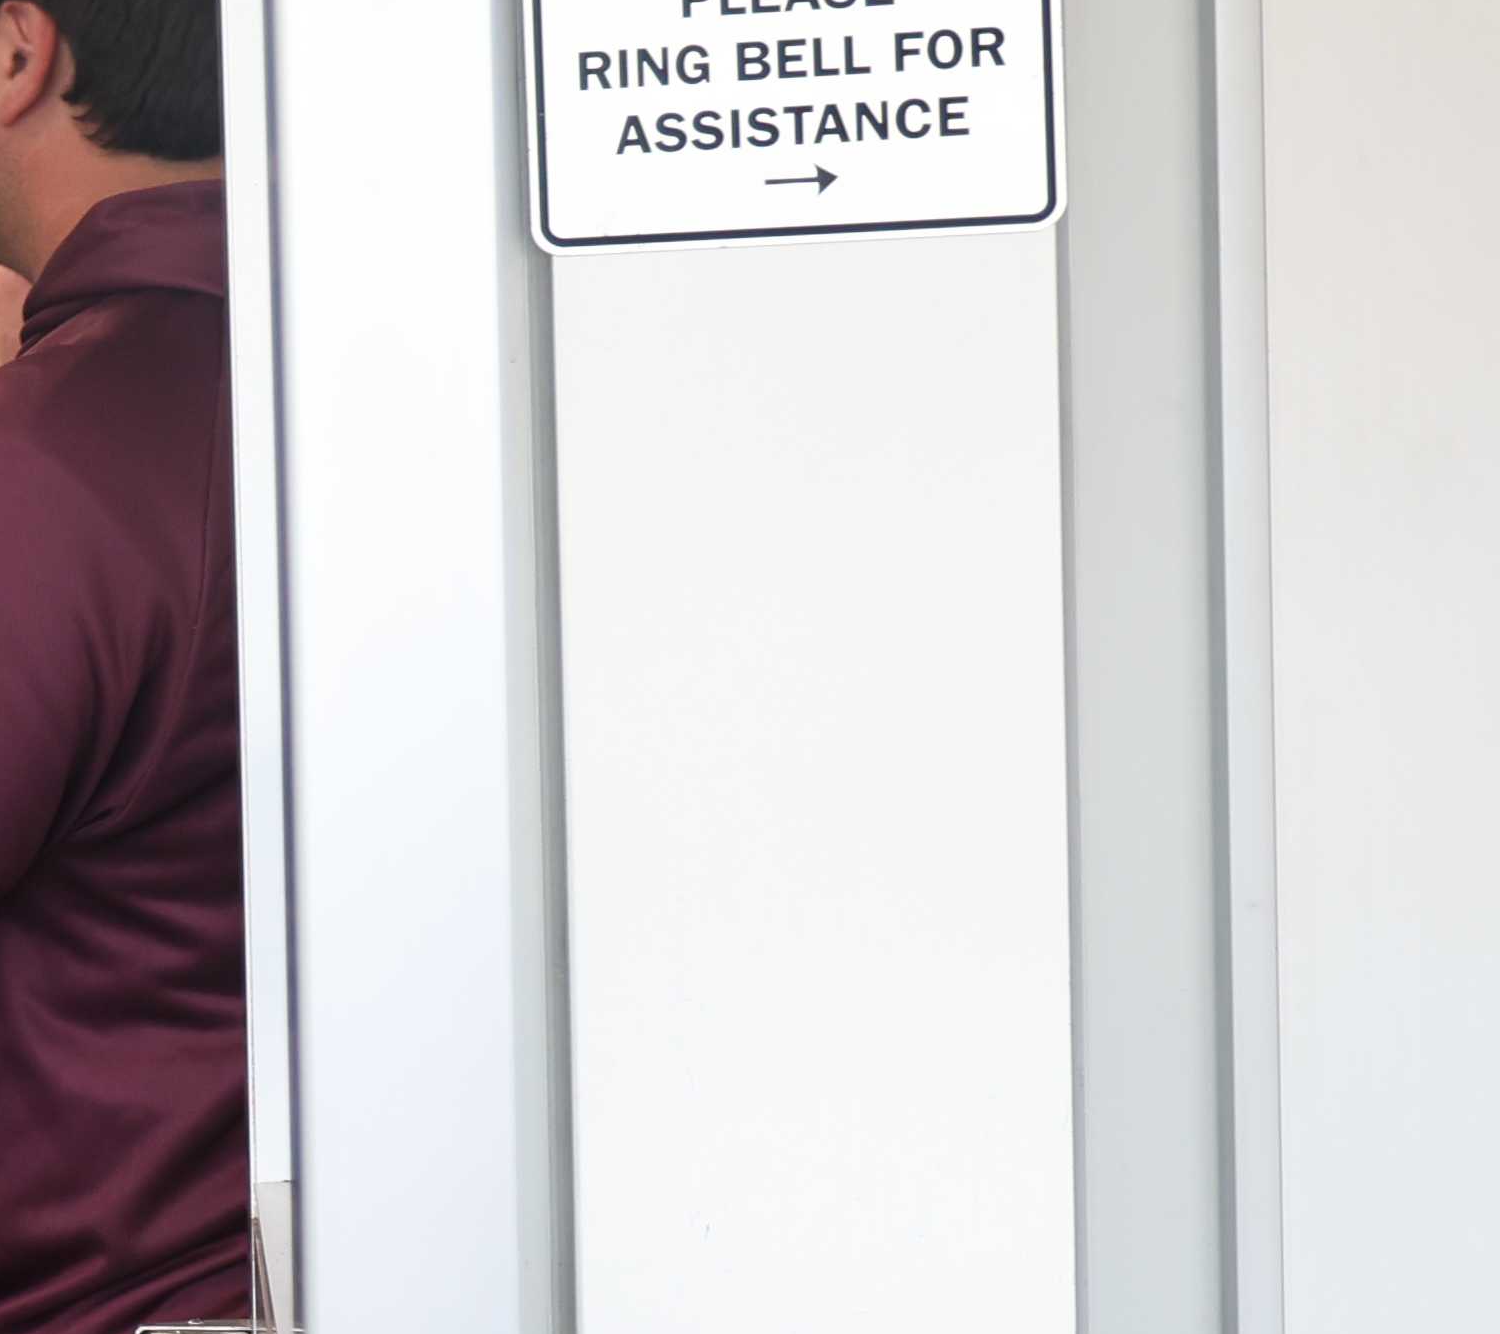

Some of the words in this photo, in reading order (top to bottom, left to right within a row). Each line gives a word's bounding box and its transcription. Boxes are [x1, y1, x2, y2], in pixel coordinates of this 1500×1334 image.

[577, 43, 711, 91] RING
[735, 35, 872, 82] BELL
[893, 26, 1006, 73] FOR
[615, 95, 970, 155] ASSISTANCE
